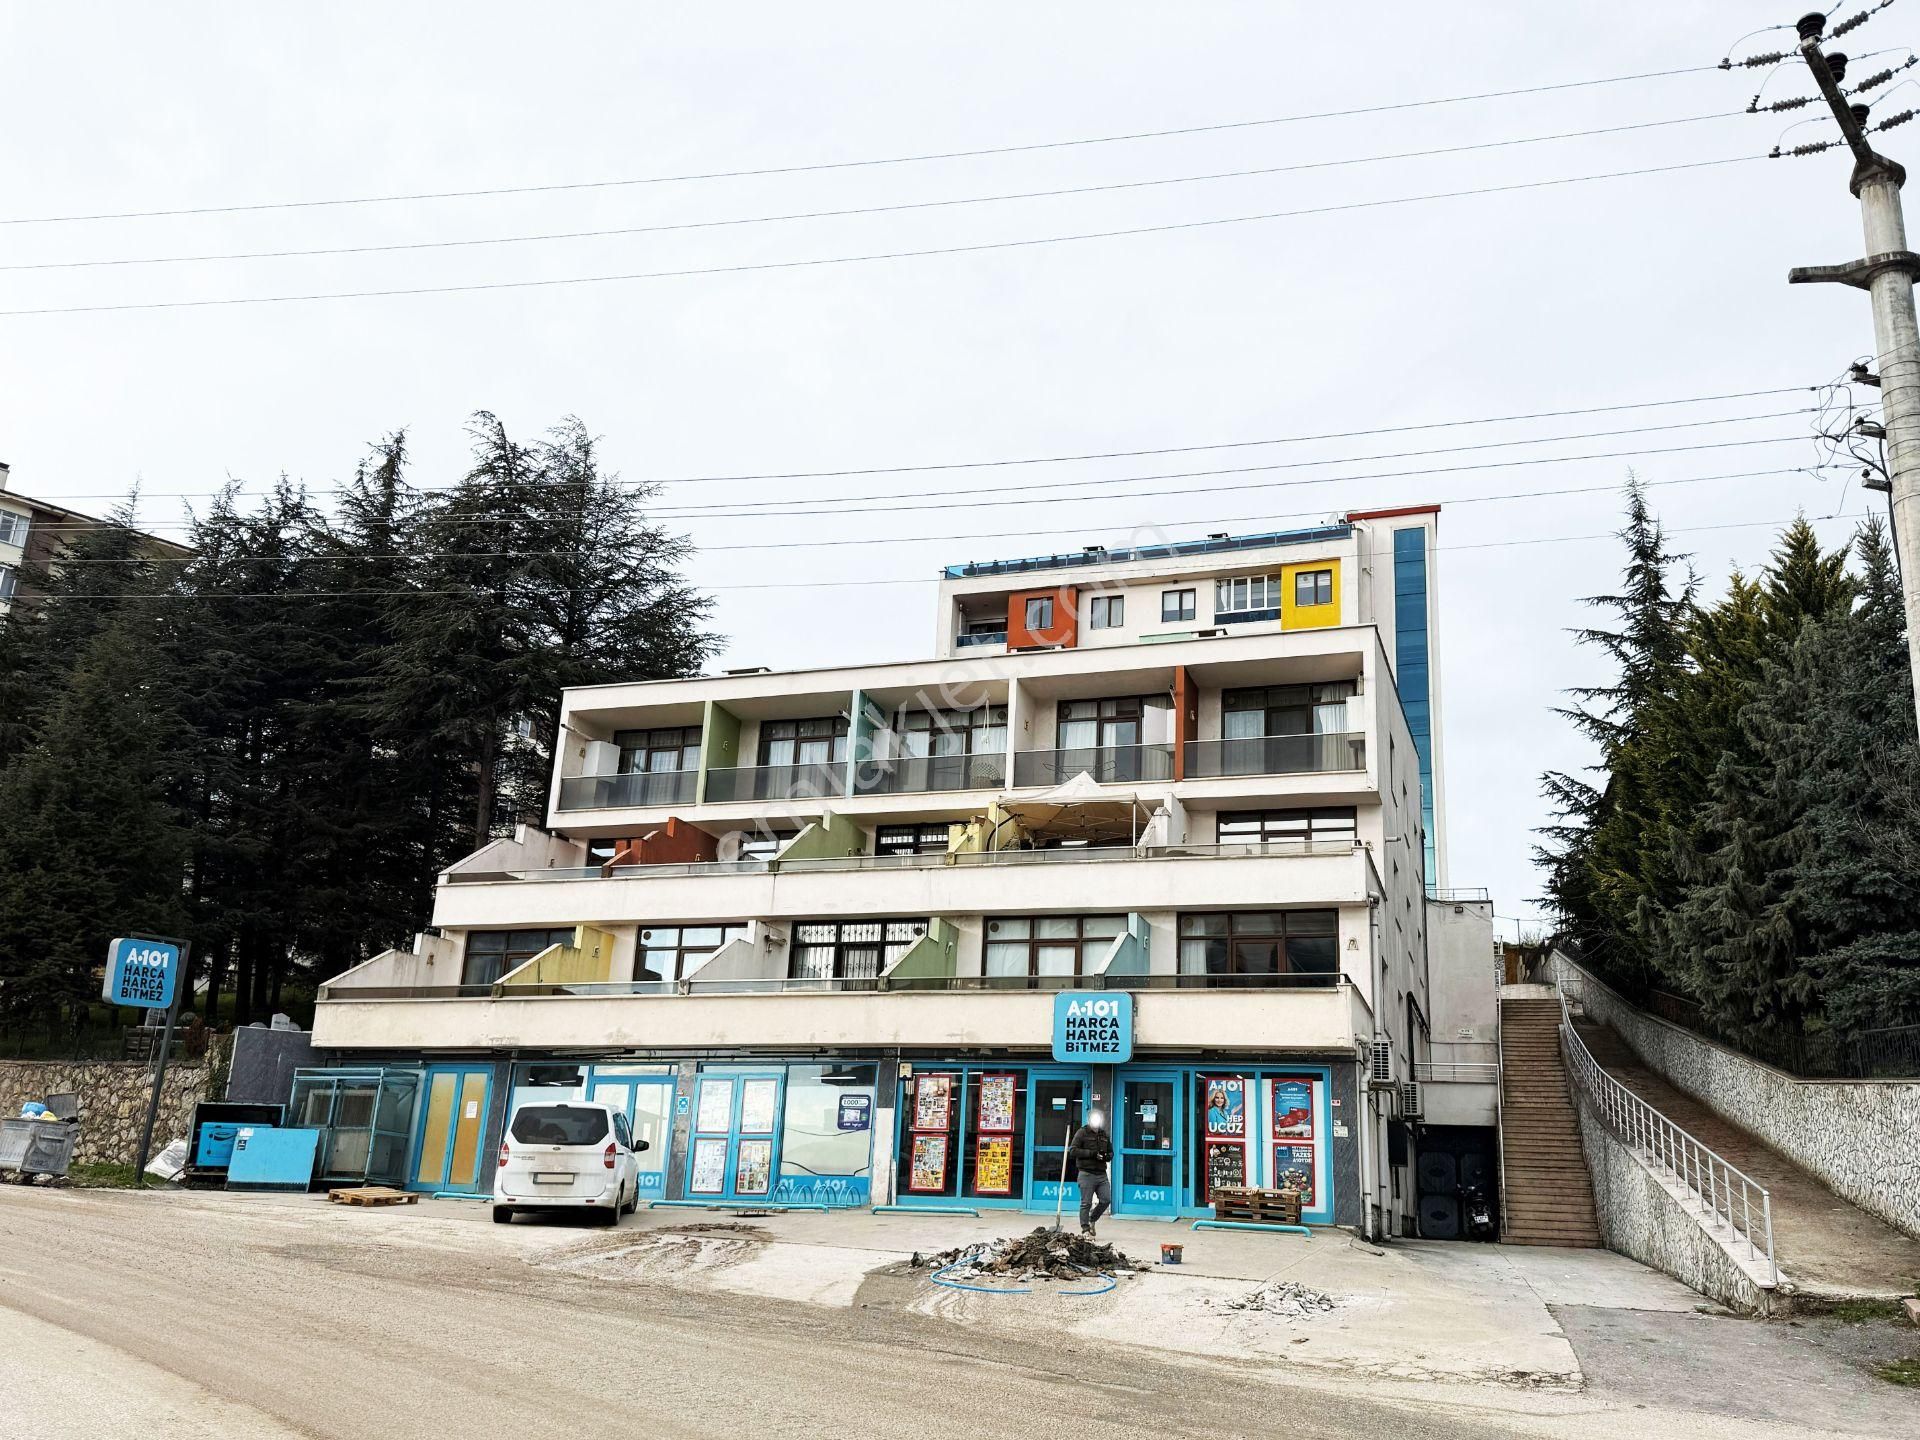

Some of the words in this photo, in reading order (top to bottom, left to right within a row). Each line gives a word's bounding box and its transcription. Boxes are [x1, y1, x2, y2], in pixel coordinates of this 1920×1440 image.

[124, 965, 165, 980] HARCA
[122, 976, 163, 991] HARCA
[1066, 1017, 1120, 1029] HARCA
[1066, 1029, 1120, 1041] HARCA
[1209, 1122, 1244, 1134] UCUZ
